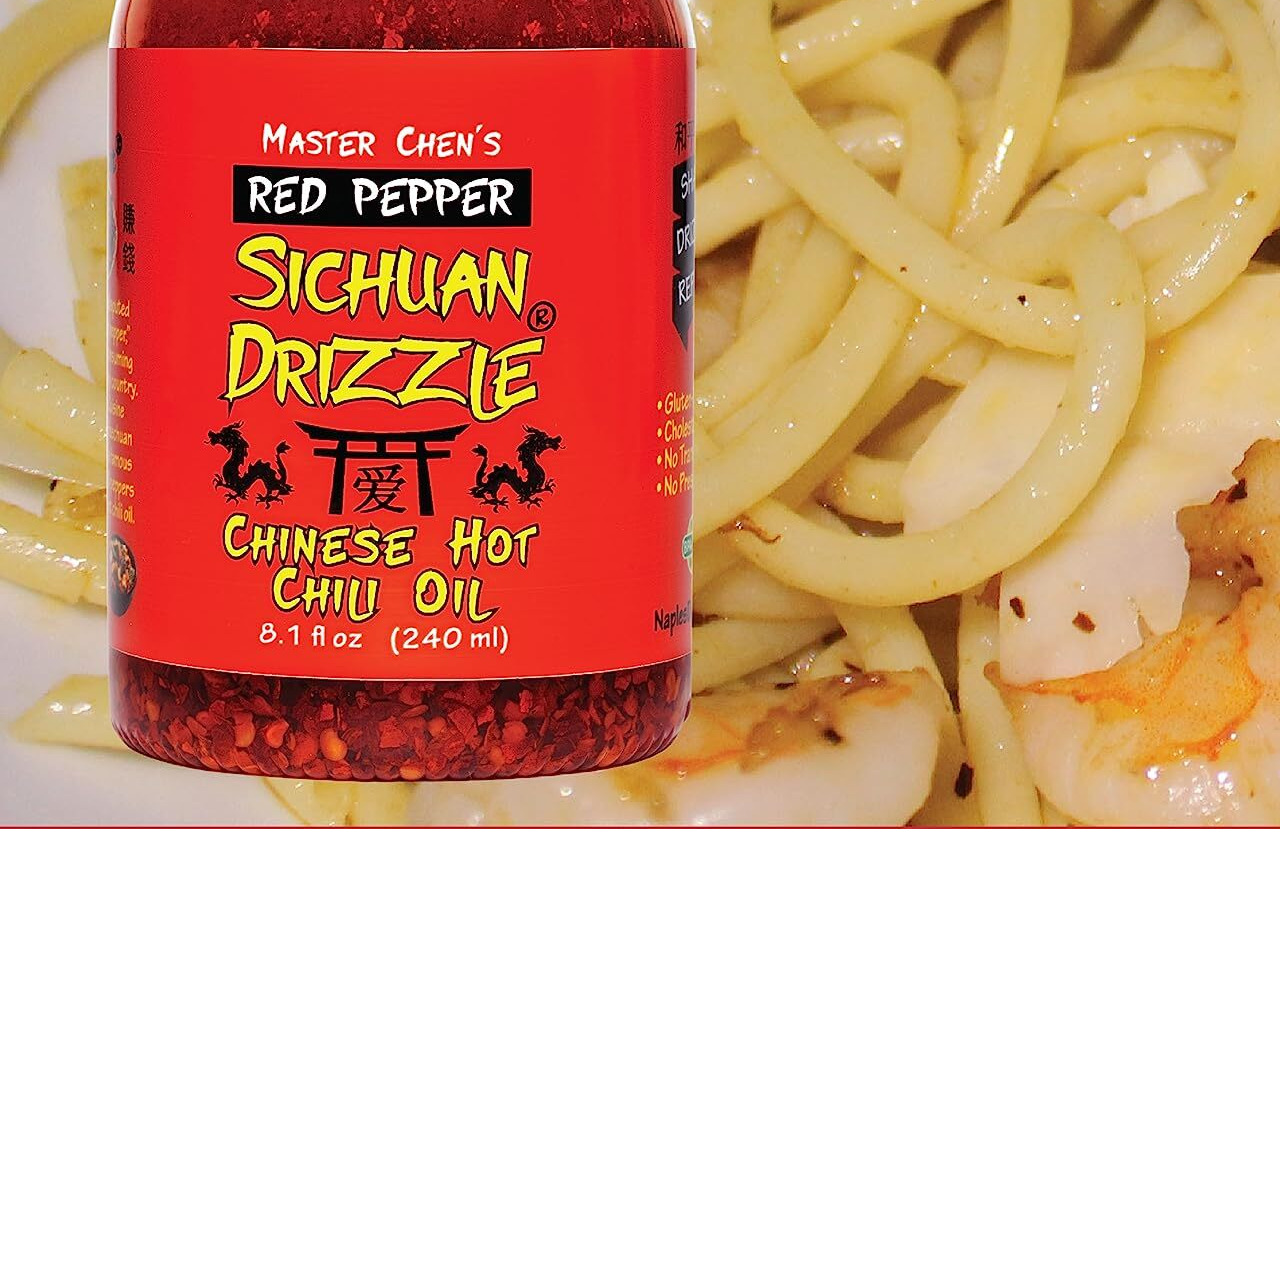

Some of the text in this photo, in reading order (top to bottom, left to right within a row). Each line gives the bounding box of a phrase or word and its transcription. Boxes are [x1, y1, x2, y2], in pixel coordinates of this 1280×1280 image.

[261, 122, 376, 157] MASTER
[247, 175, 515, 217] RED PEPPER
[228, 232, 532, 319] SICHUAN
[220, 319, 545, 423] DRIZZLE
[222, 512, 539, 568] CHINESE HOT
[271, 565, 500, 623] CHILI OIL
[259, 622, 300, 645] 8.1
[390, 626, 463, 656] (240
[470, 625, 509, 654] ml)
